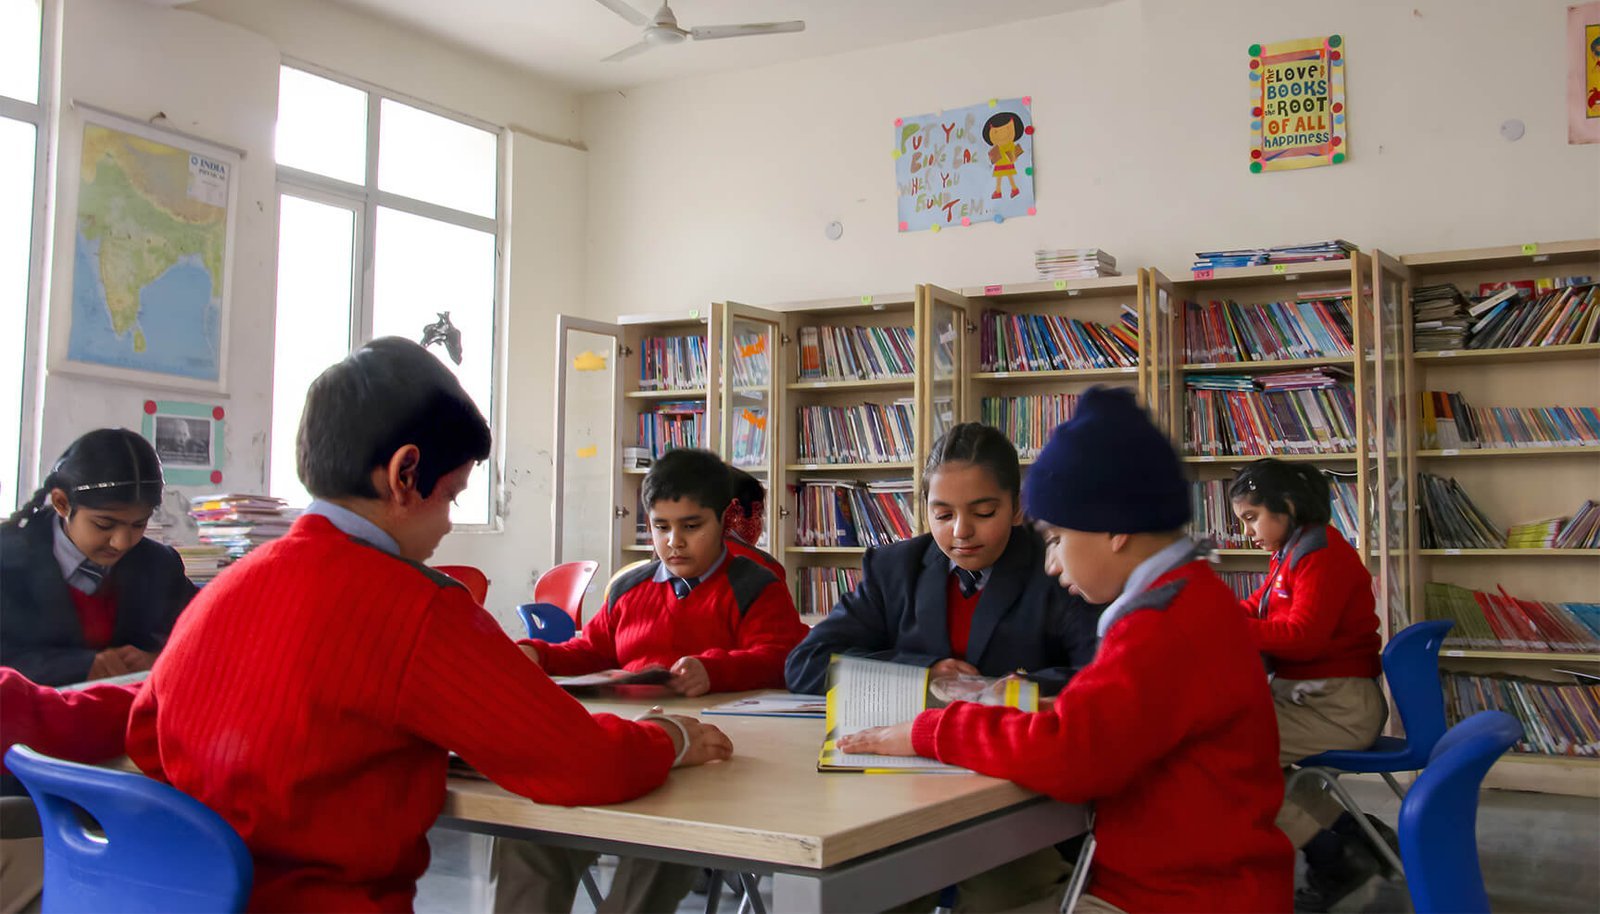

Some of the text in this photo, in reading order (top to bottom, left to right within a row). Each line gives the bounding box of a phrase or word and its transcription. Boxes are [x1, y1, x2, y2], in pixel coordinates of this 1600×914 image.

[1267, 80, 1327, 99] BOOKS
[1277, 97, 1327, 117] ROOT
[1268, 115, 1326, 135] OF ALL
[901, 122, 937, 155] PUT
[200, 159, 225, 174] INDIA
